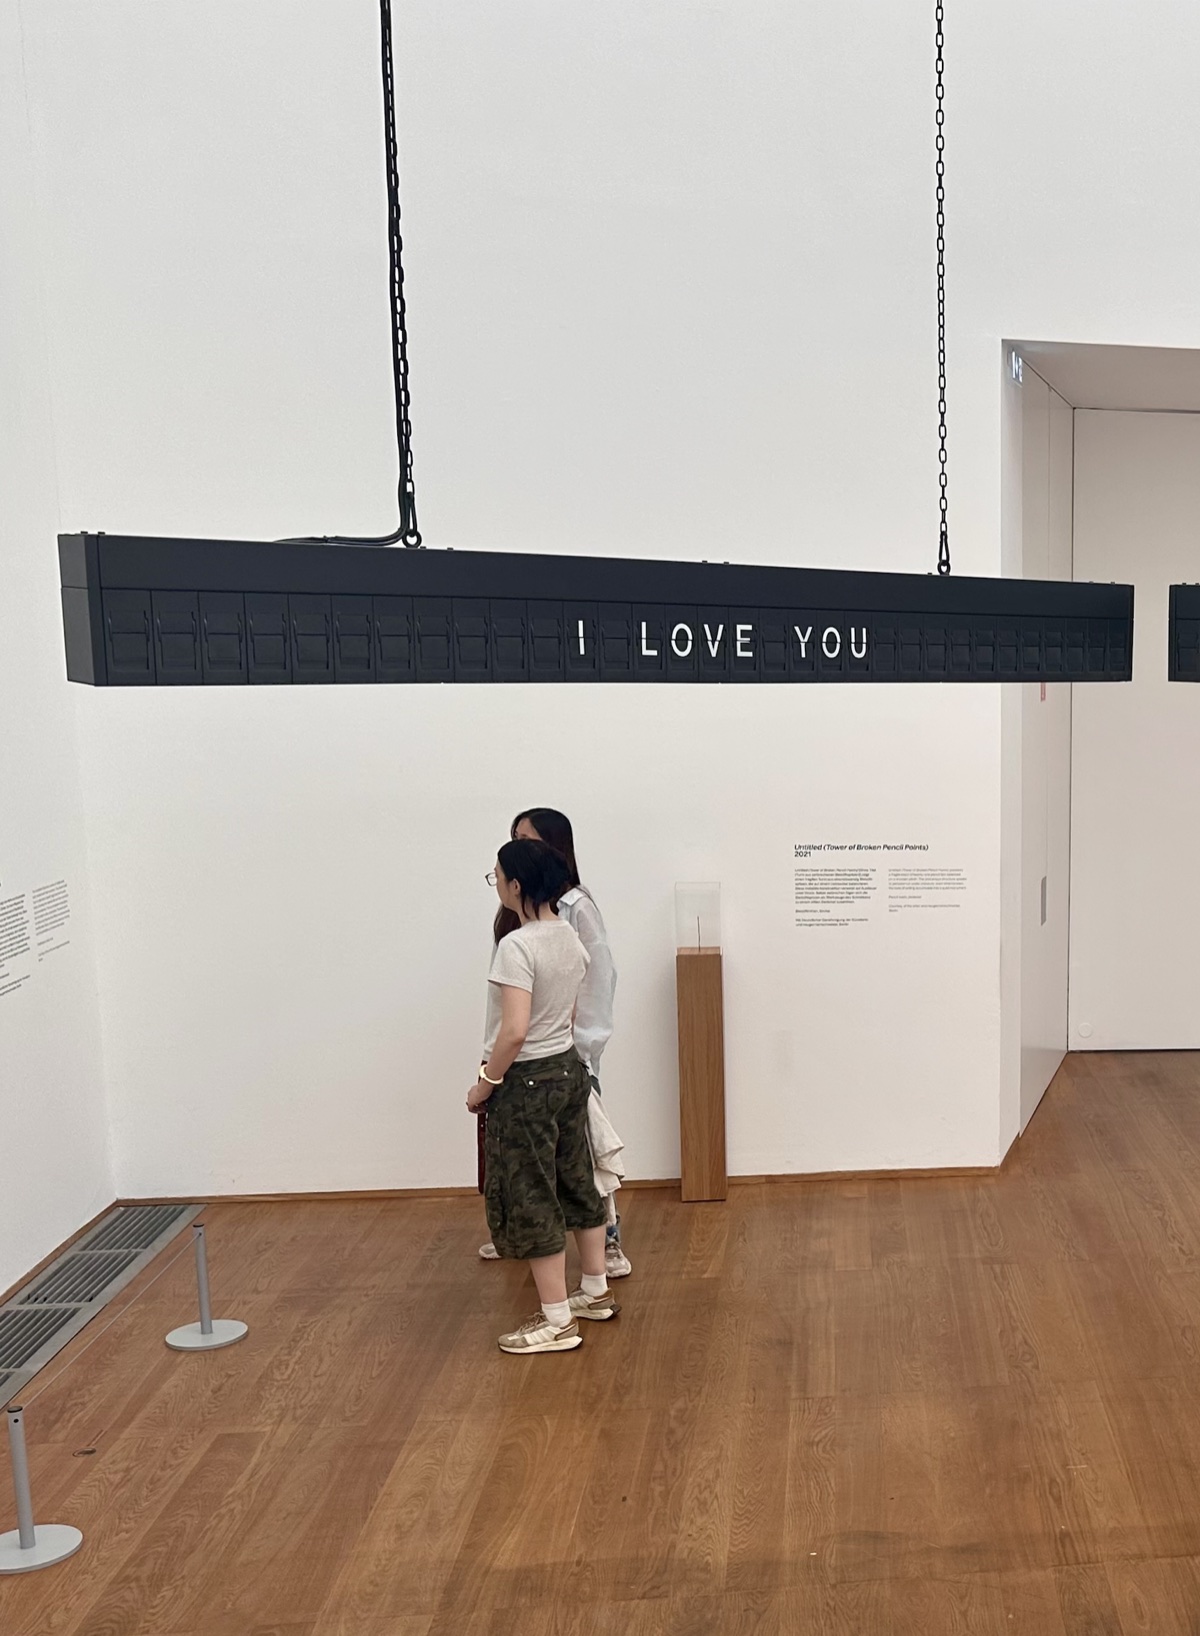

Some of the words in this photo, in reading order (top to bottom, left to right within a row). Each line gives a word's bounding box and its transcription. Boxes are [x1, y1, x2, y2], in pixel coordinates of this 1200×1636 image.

[578, 620, 585, 655] I
[641, 621, 754, 658] LOVE
[793, 625, 867, 659] YOU
[823, 844, 847, 852] (Tower
[904, 844, 929, 852] Points)
